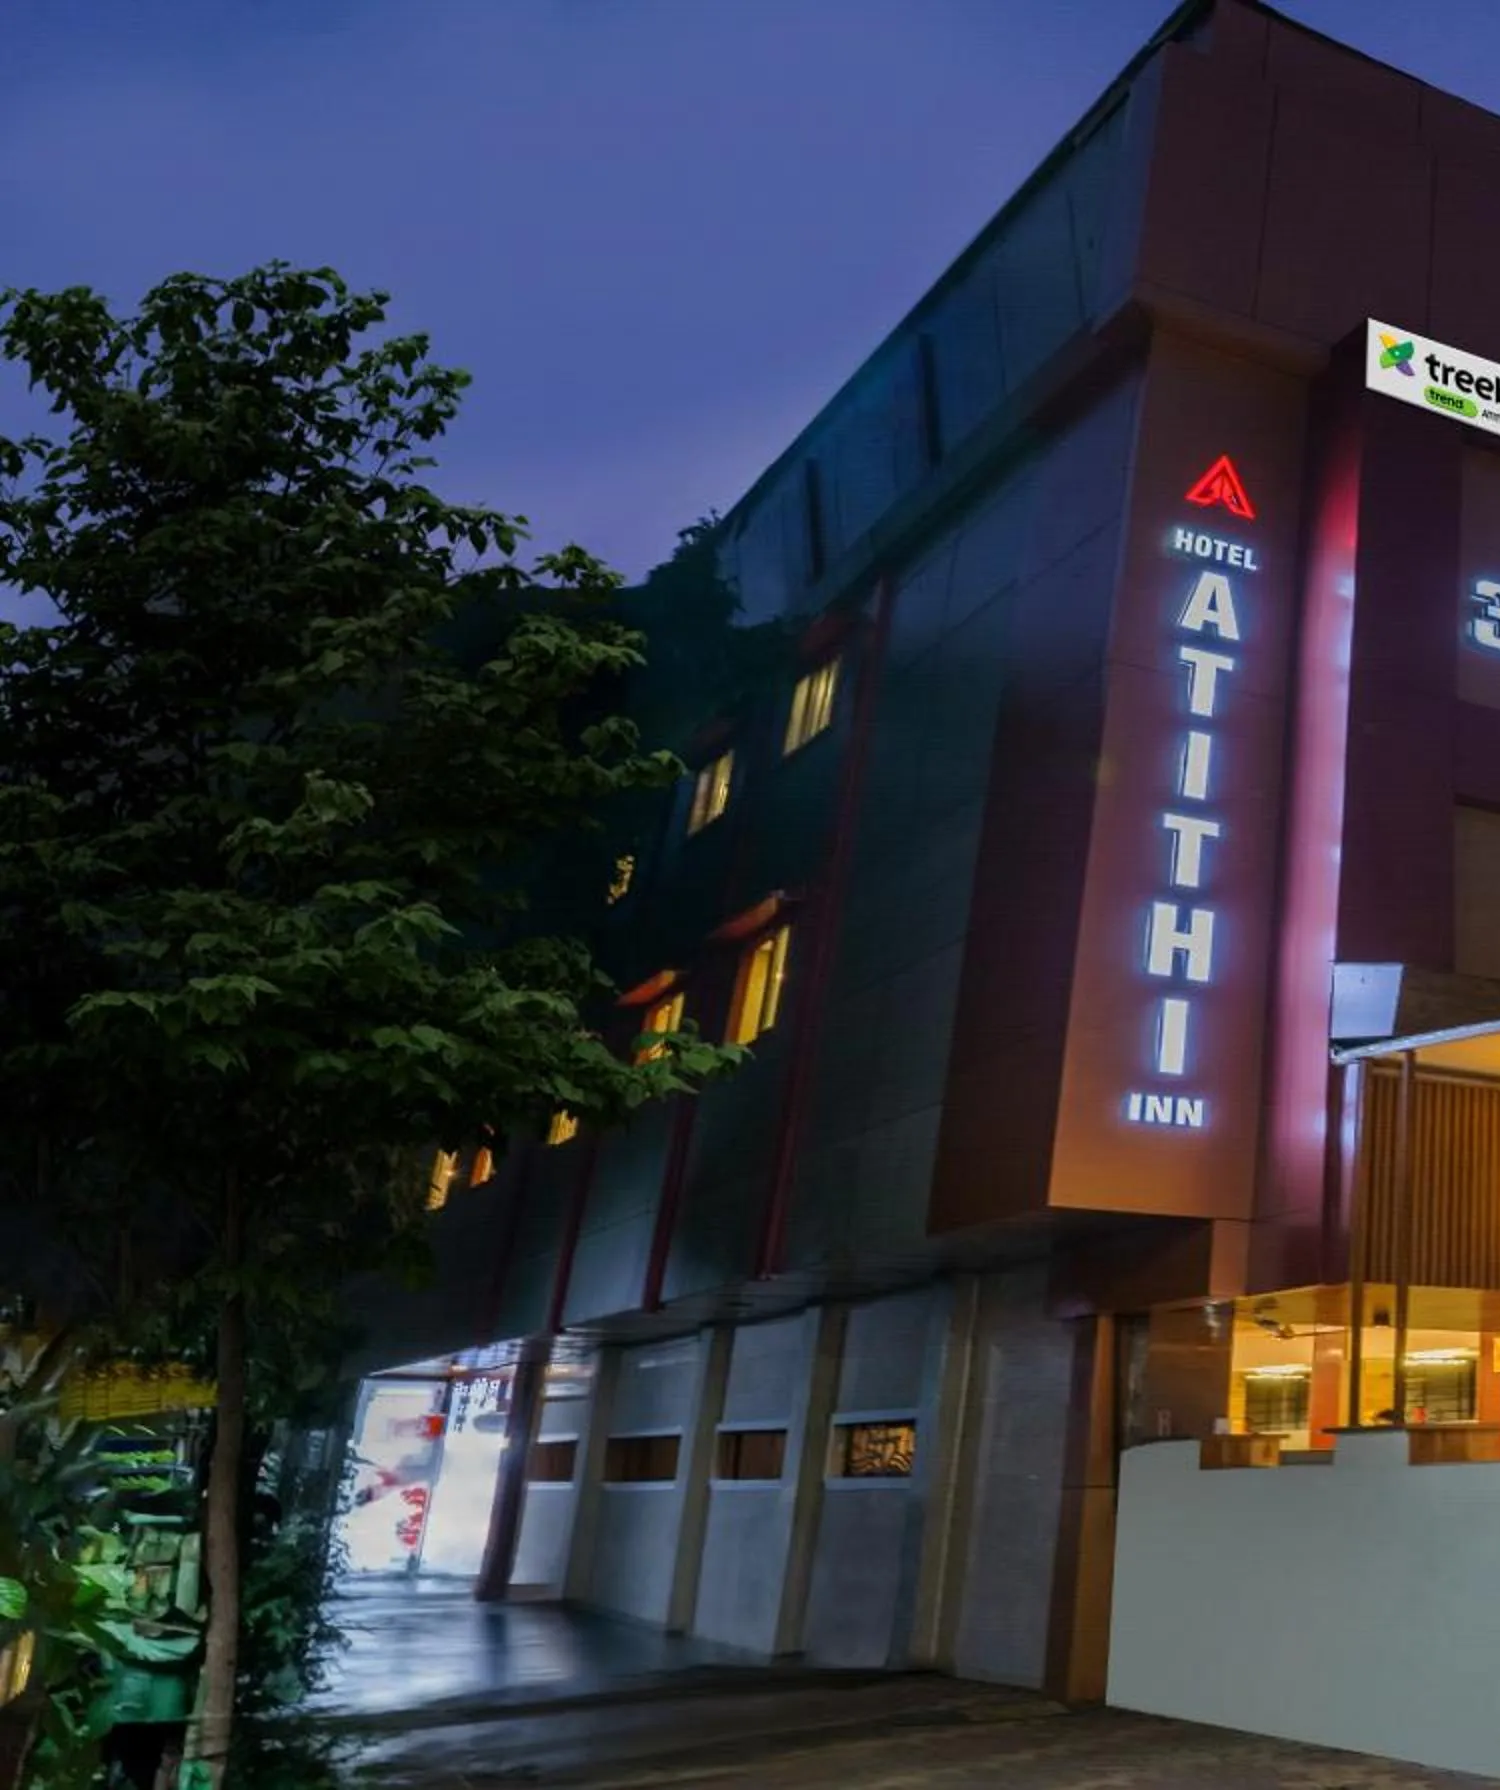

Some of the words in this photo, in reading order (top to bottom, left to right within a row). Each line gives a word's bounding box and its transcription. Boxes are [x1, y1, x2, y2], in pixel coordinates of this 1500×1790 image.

[1429, 388, 1464, 409] trend
[1175, 527, 1258, 571] HOTEL
[1146, 571, 1241, 1075] ATITHI
[1127, 1092, 1204, 1128] INN
